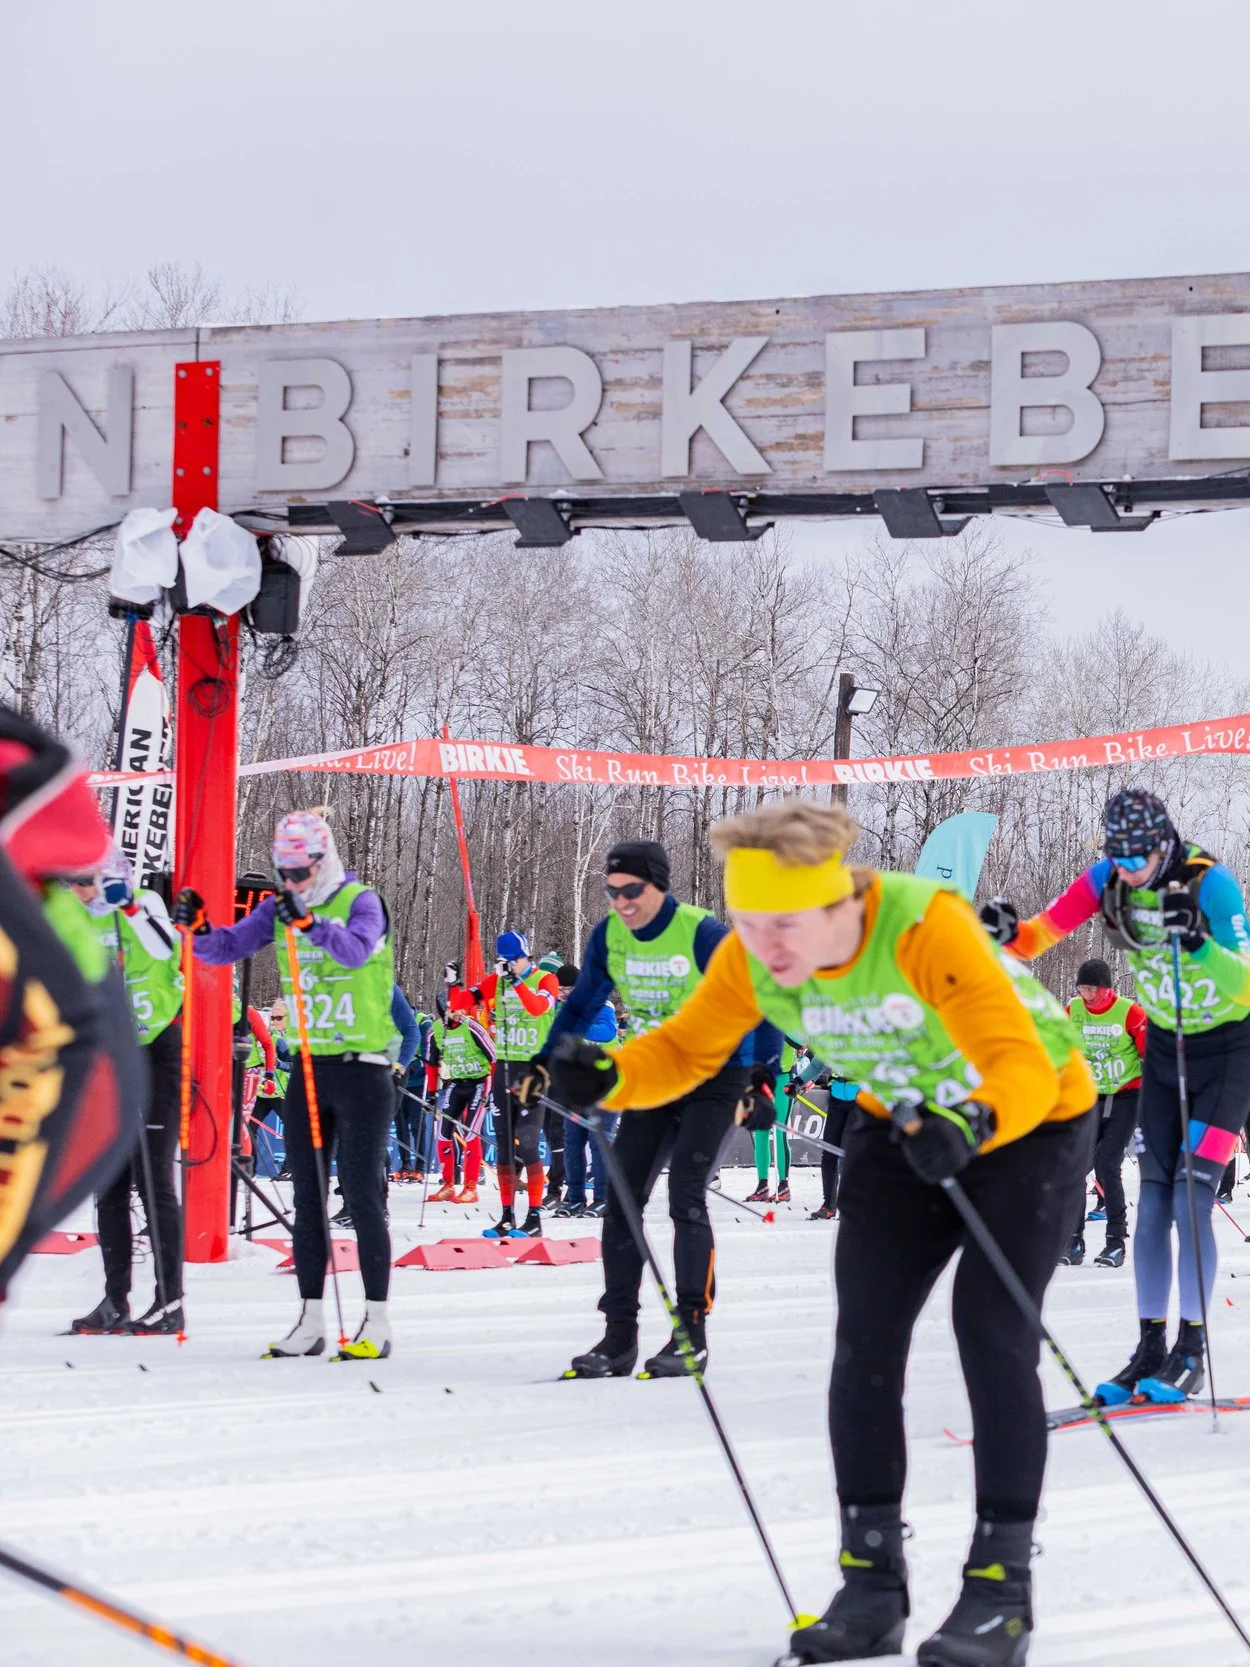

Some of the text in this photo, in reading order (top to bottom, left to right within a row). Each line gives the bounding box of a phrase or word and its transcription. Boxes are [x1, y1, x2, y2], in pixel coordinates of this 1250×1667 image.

[439, 742, 531, 776] BIRKIE
[557, 755, 602, 784] Ski.
[607, 760, 665, 786] Run.
[834, 758, 937, 785] BIRKIE
[1104, 736, 1178, 764] Bike.
[1086, 1059, 1126, 1081] 310
